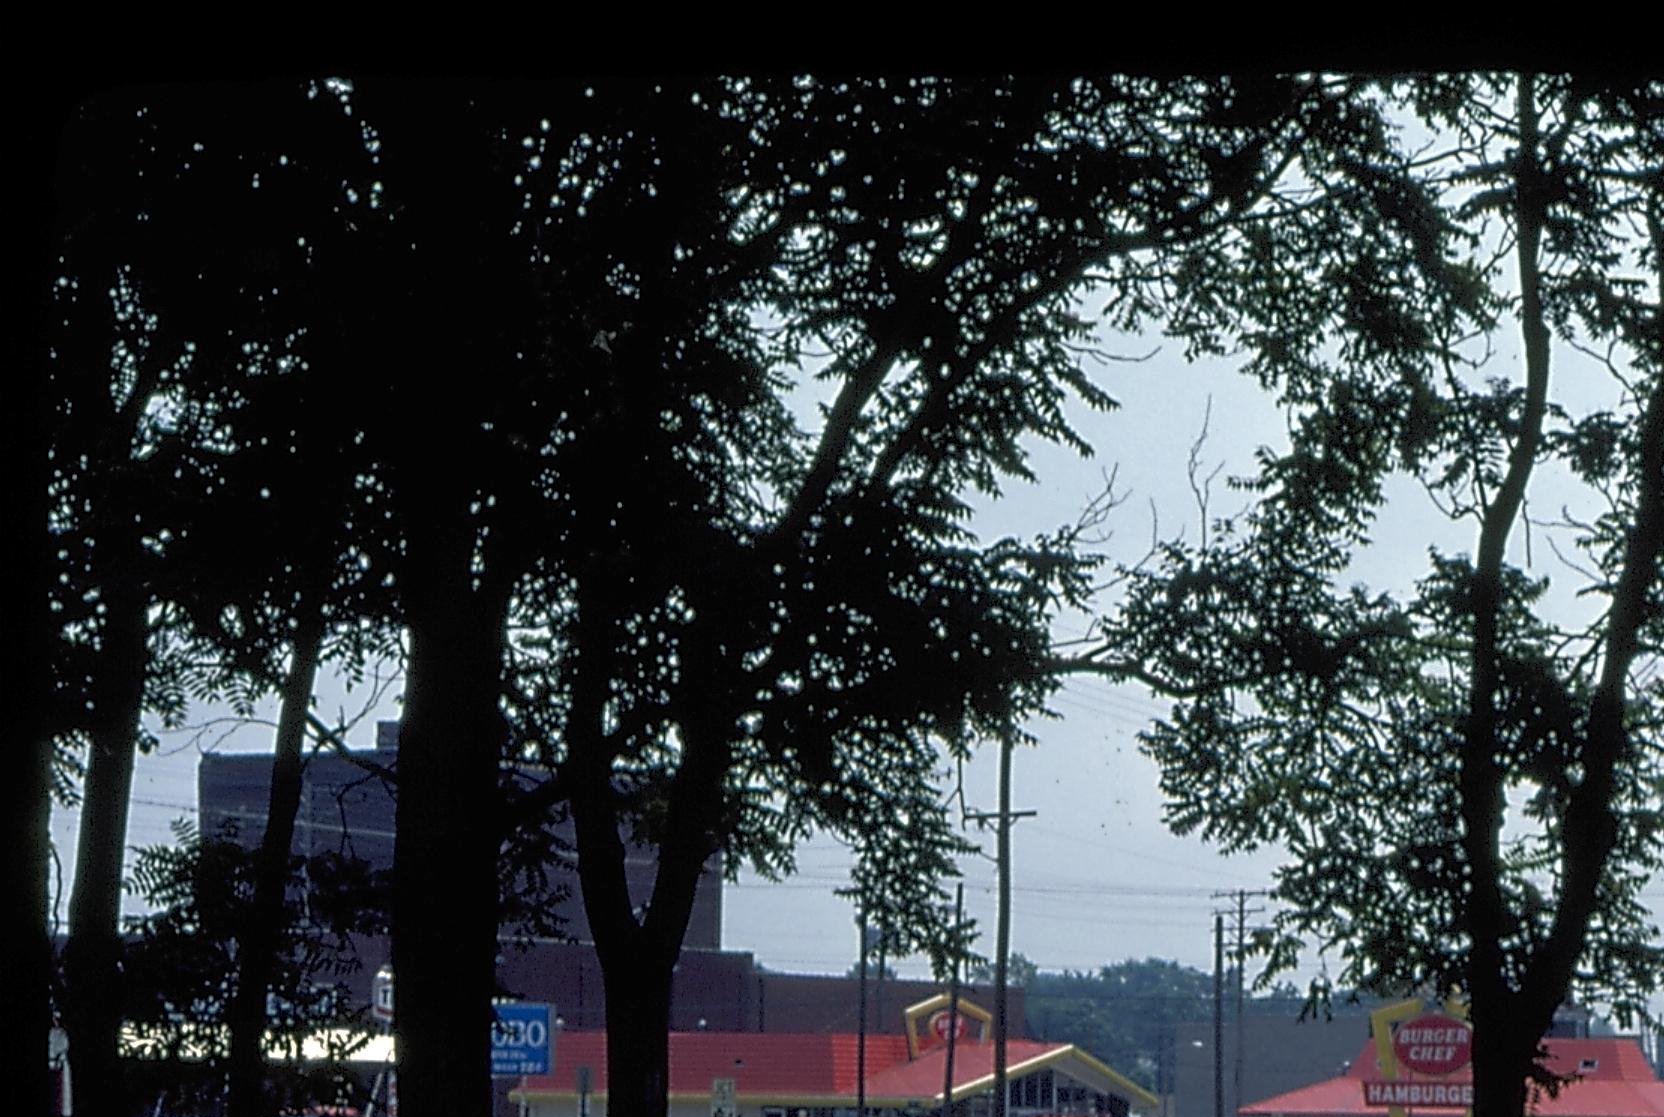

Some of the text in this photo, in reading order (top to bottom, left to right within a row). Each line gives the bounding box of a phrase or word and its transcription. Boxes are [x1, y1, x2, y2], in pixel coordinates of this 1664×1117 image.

[1399, 1028, 1468, 1044] BURGER
[1409, 1045, 1457, 1060] CHEF
[1368, 1085, 1474, 1104] HAMBURGE
